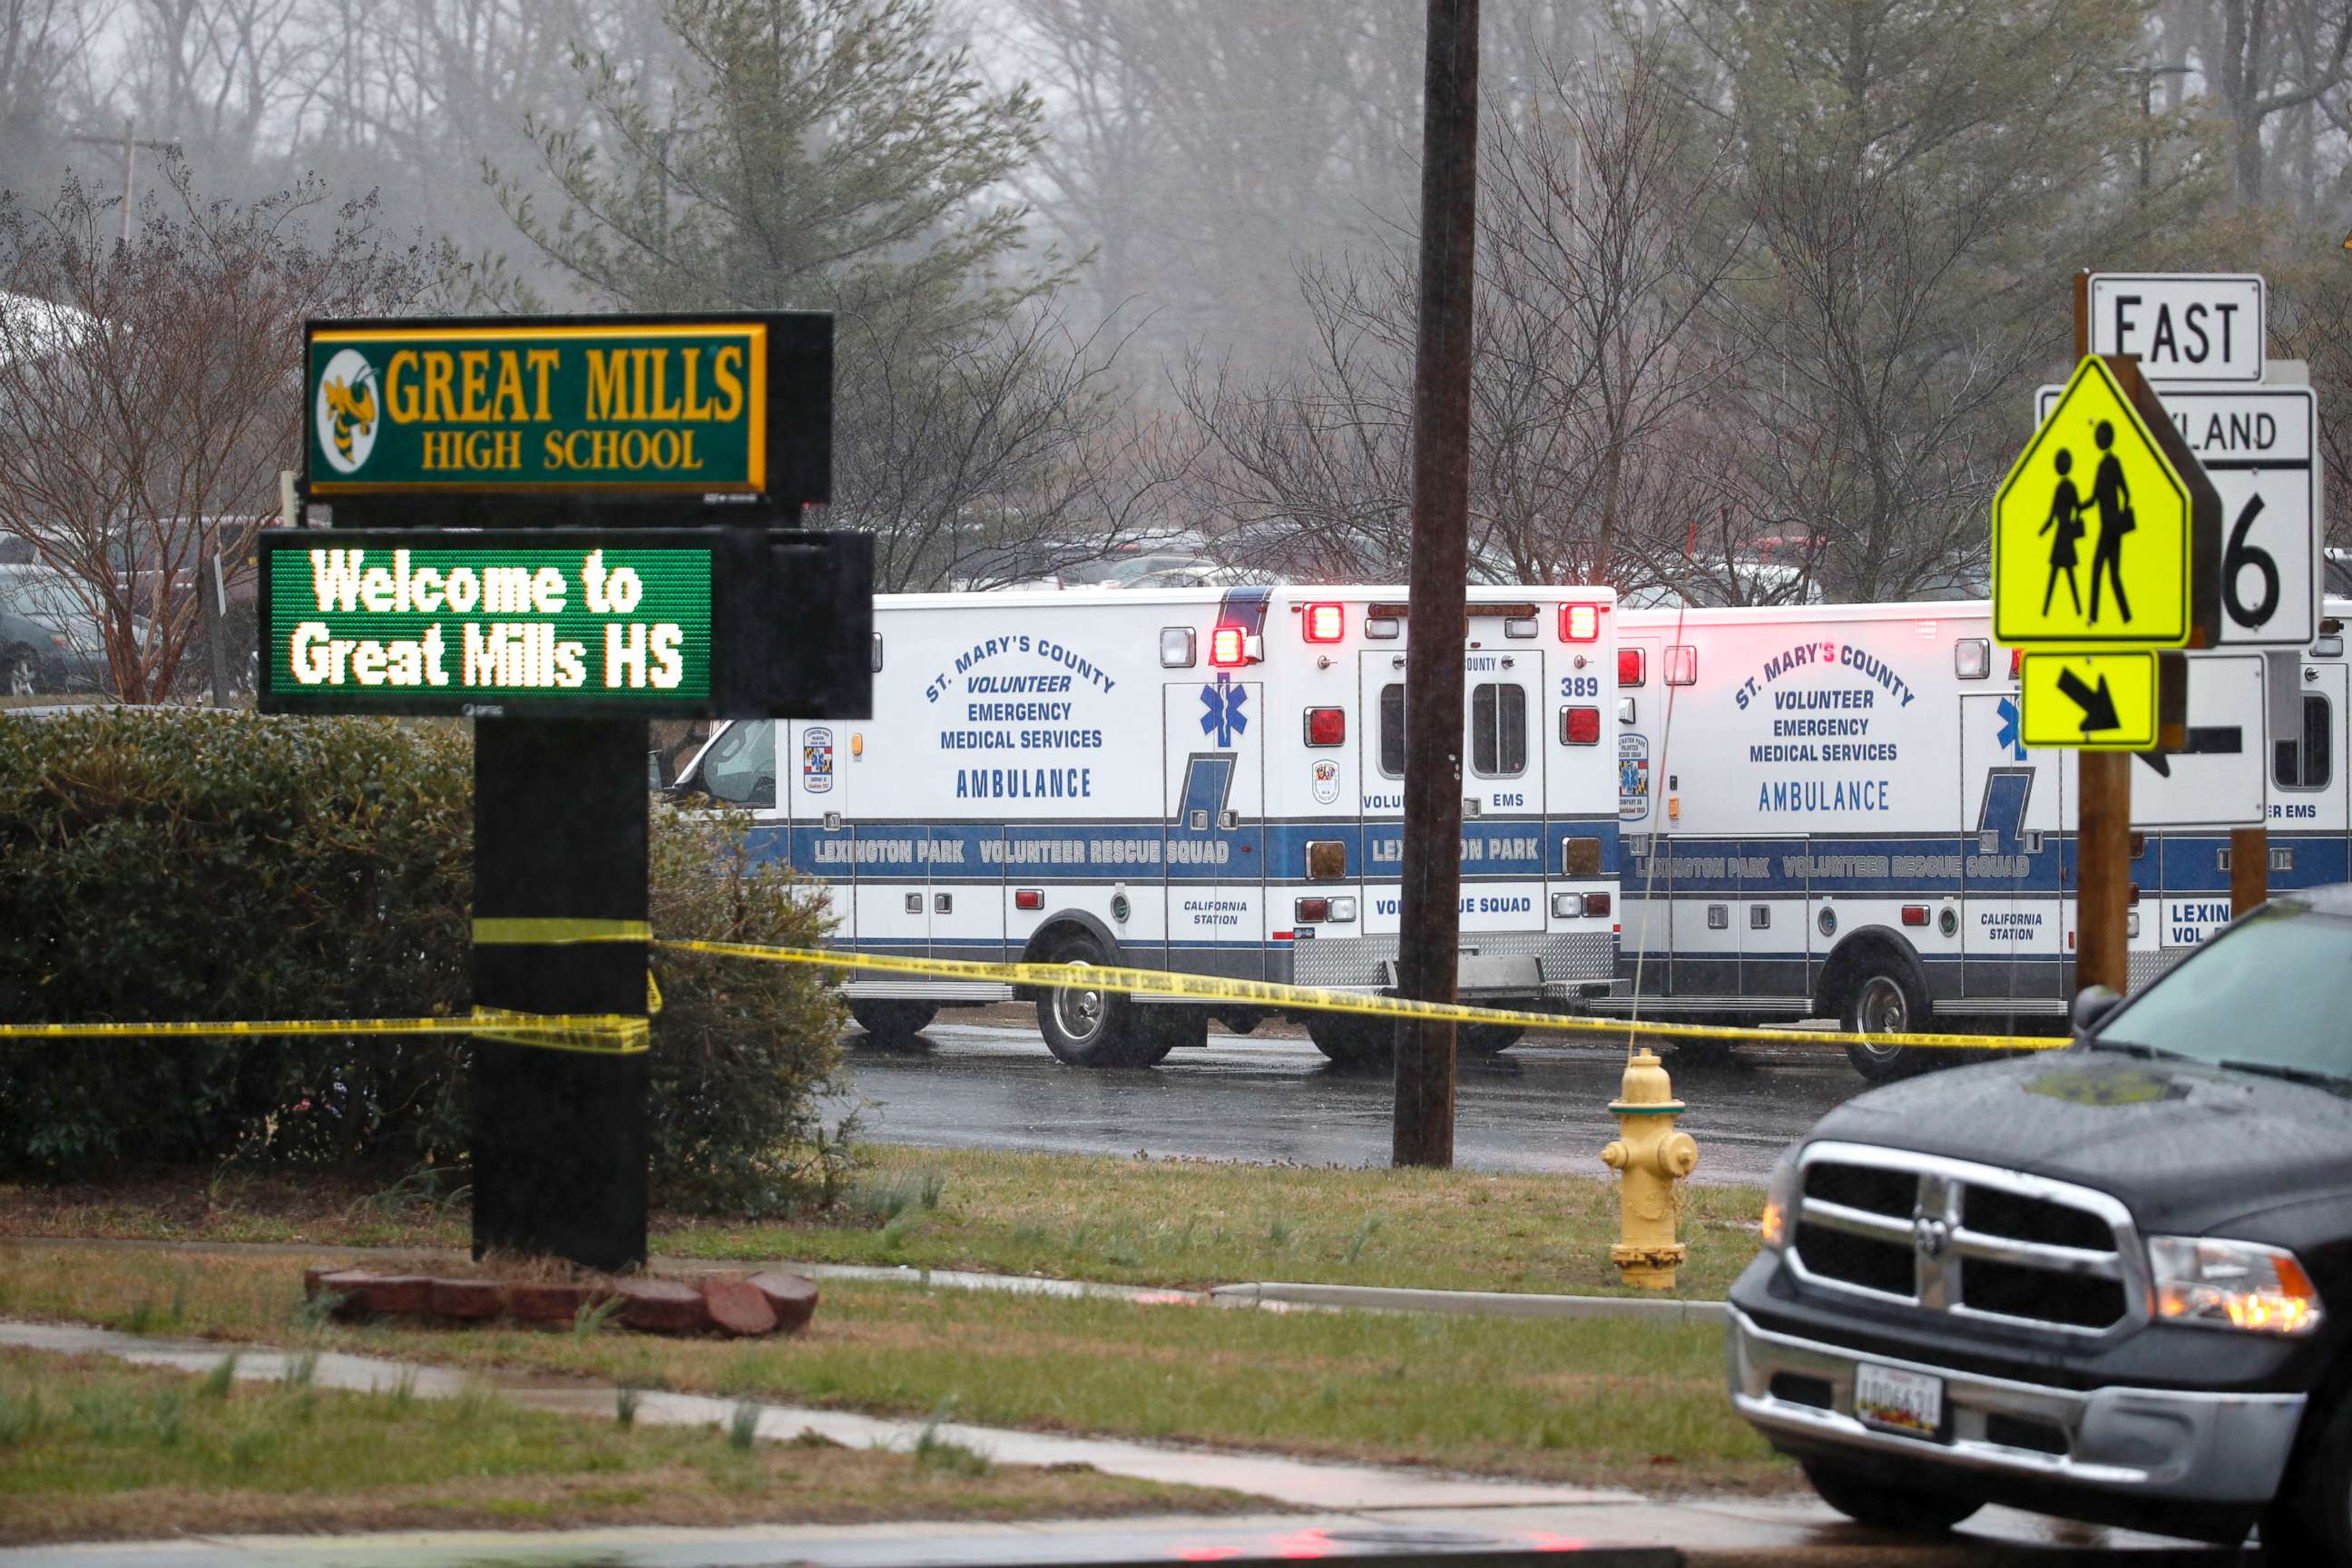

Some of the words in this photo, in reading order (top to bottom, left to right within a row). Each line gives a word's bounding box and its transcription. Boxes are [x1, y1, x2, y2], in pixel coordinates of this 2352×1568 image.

[2115, 295, 2239, 363] EAST
[385, 346, 560, 424] GREAT
[585, 345, 743, 423] MILLS
[422, 430, 523, 470] HIGH
[544, 428, 703, 470] SCHOOL
[309, 548, 567, 613] Welcome
[580, 548, 643, 614] to
[290, 620, 449, 686] Great
[462, 622, 587, 688] Mills
[603, 622, 684, 689] HS
[1466, 657, 1496, 671] OUNTY
[926, 673, 953, 703] ST.
[955, 635, 1031, 674] MARY'S
[1037, 639, 1116, 695] COUNTY
[1735, 676, 1762, 710] ST.
[1763, 641, 1836, 682] MARY'S
[1840, 644, 1916, 709] COUNTY
[967, 675, 1072, 693] VOLUNTEER
[1560, 676, 1599, 698] 389
[1775, 690, 1875, 710] VOLUNTEER
[967, 702, 1073, 721] EMERGENCY
[1773, 718, 1869, 737] EMERGENCY
[940, 730, 1015, 750] MEDICAL
[1020, 729, 1102, 749] SERVICES
[1749, 744, 1818, 762] MEDICAL
[1822, 743, 1897, 762] SERVICES
[956, 768, 1091, 799] AMBULANCE
[1493, 793, 1524, 807] EMS
[1759, 779, 1889, 812] AMBULANCE
[2286, 804, 2317, 818] EMS
[814, 839, 913, 863] LEXINGTON
[916, 839, 965, 863] PARK
[979, 839, 1085, 864] VOLUNTEER
[1089, 839, 1161, 864] RESCUE
[1166, 839, 1230, 864] SQUAD
[1488, 837, 1539, 860] PARK
[1635, 857, 1725, 878] LEXINGTON
[1727, 857, 1770, 878] PARK
[1782, 856, 1889, 878] VOLUNTEER
[1891, 856, 1962, 878] RESCUE
[1965, 856, 2031, 878] SQUAD
[1183, 900, 1248, 912] CALIFORNIA
[1480, 897, 1531, 913] SQUAD
[1193, 915, 1238, 926] STATION
[1981, 914, 2043, 926] CALIFORNIA
[1989, 928, 2034, 941] STATION
